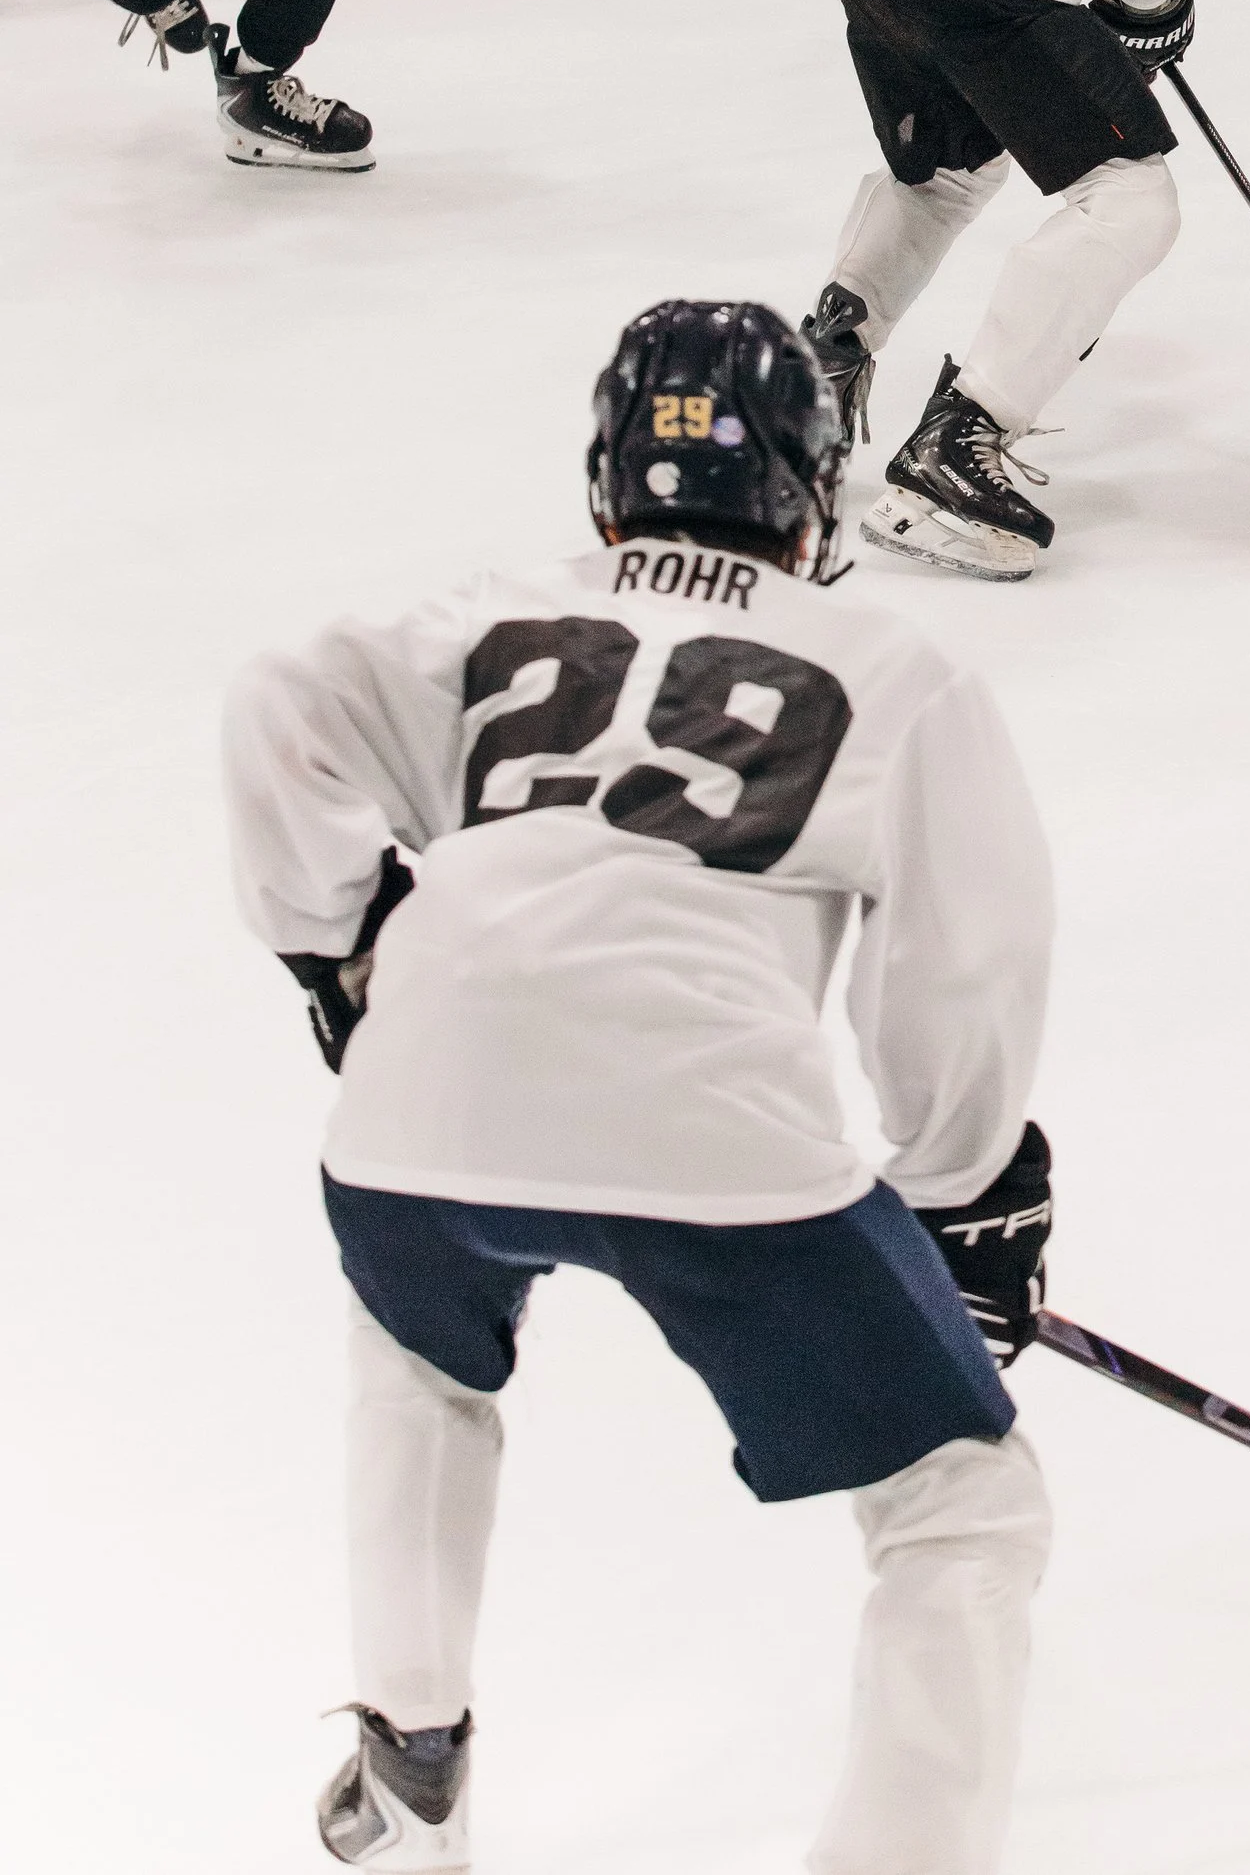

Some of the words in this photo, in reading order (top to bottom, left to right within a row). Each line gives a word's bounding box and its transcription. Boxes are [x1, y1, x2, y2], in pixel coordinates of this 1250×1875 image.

[653, 395, 713, 439] 29
[940, 464, 975, 498] BAUER
[612, 550, 760, 612] ROHR
[461, 616, 854, 875] 29
